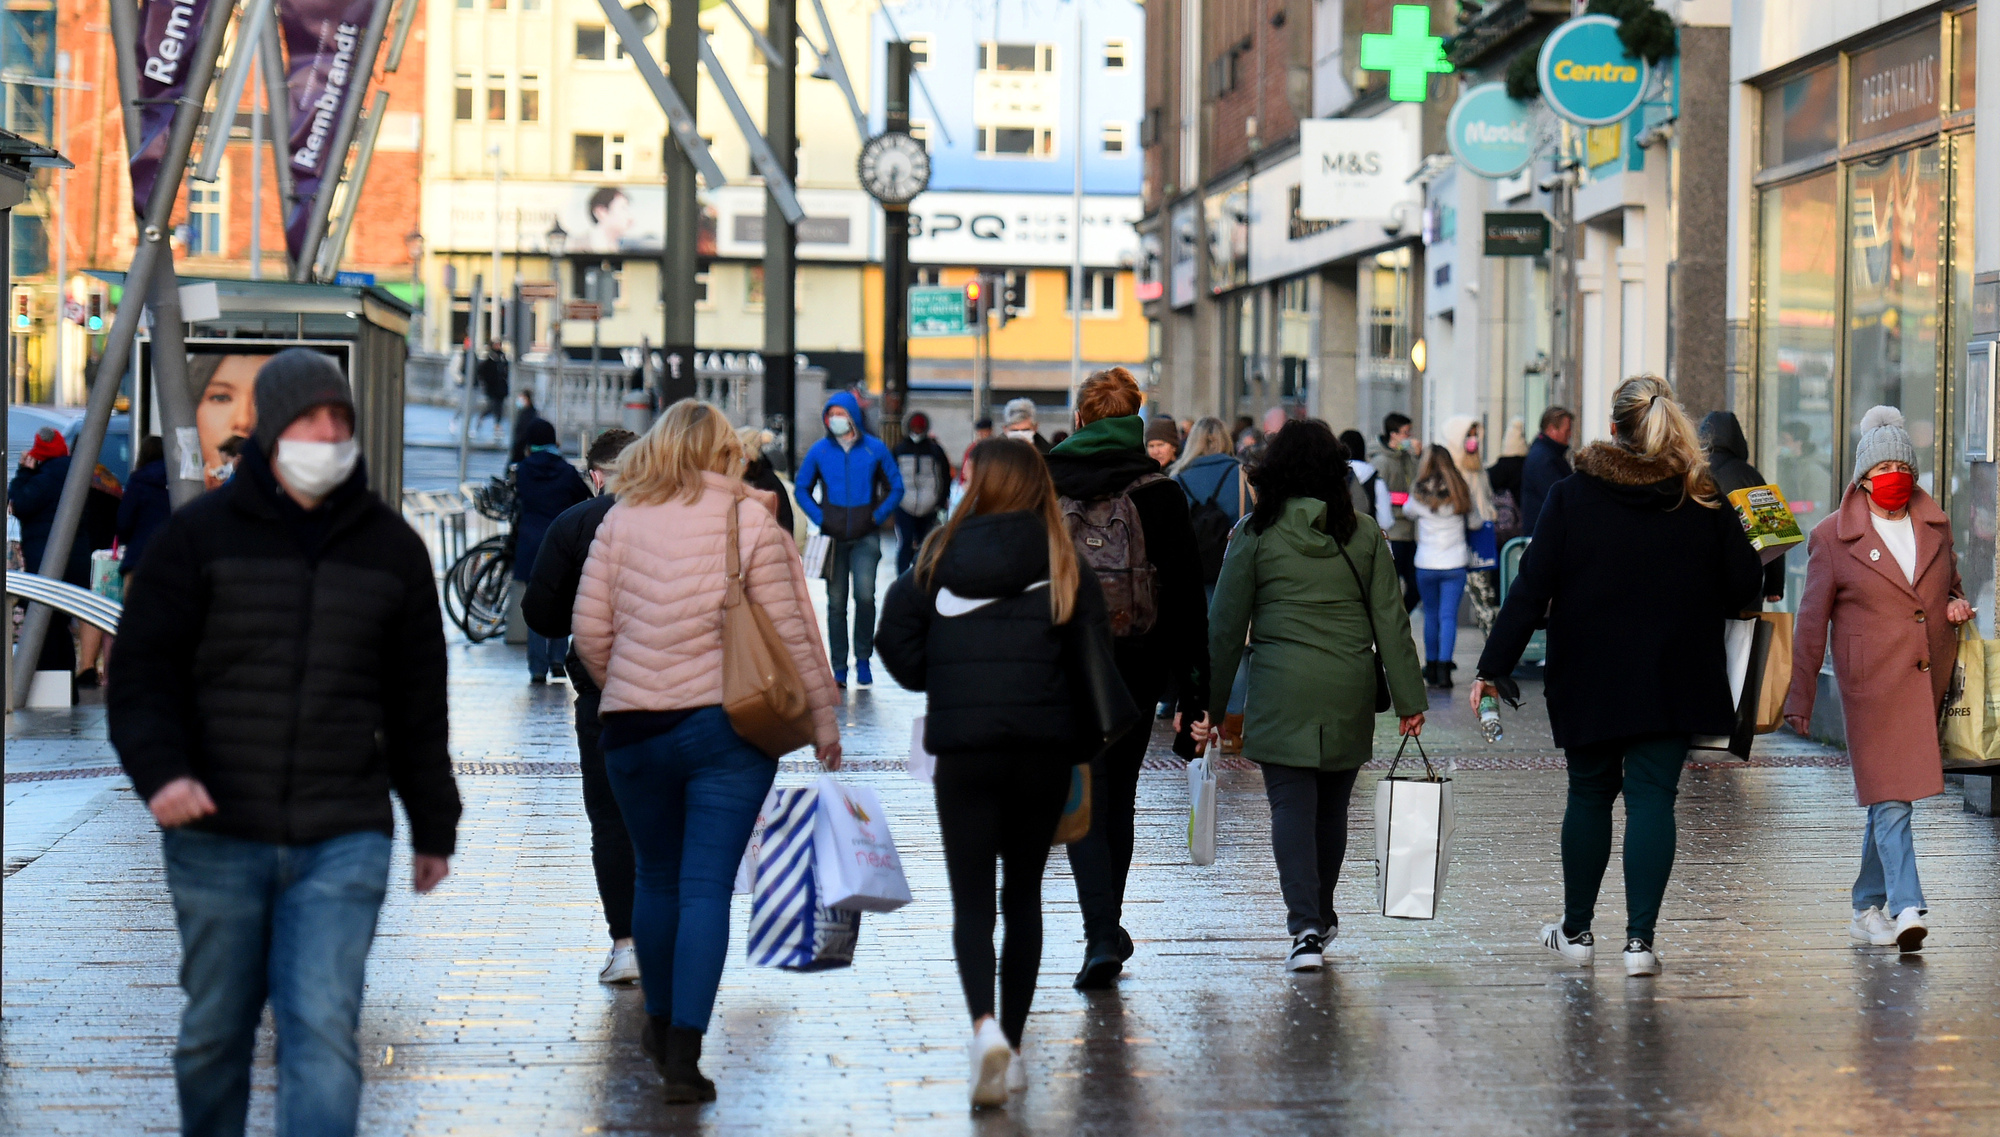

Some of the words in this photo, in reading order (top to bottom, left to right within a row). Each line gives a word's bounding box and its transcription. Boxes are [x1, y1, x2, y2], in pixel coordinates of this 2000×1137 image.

[144, 0, 195, 85] Rem
[1554, 59, 1637, 83] Centra
[1861, 54, 1934, 124] DEBENHAMS
[294, 21, 360, 169] Rembrandt
[1321, 151, 1382, 174] M&S
[1946, 706, 1971, 717] ORES
